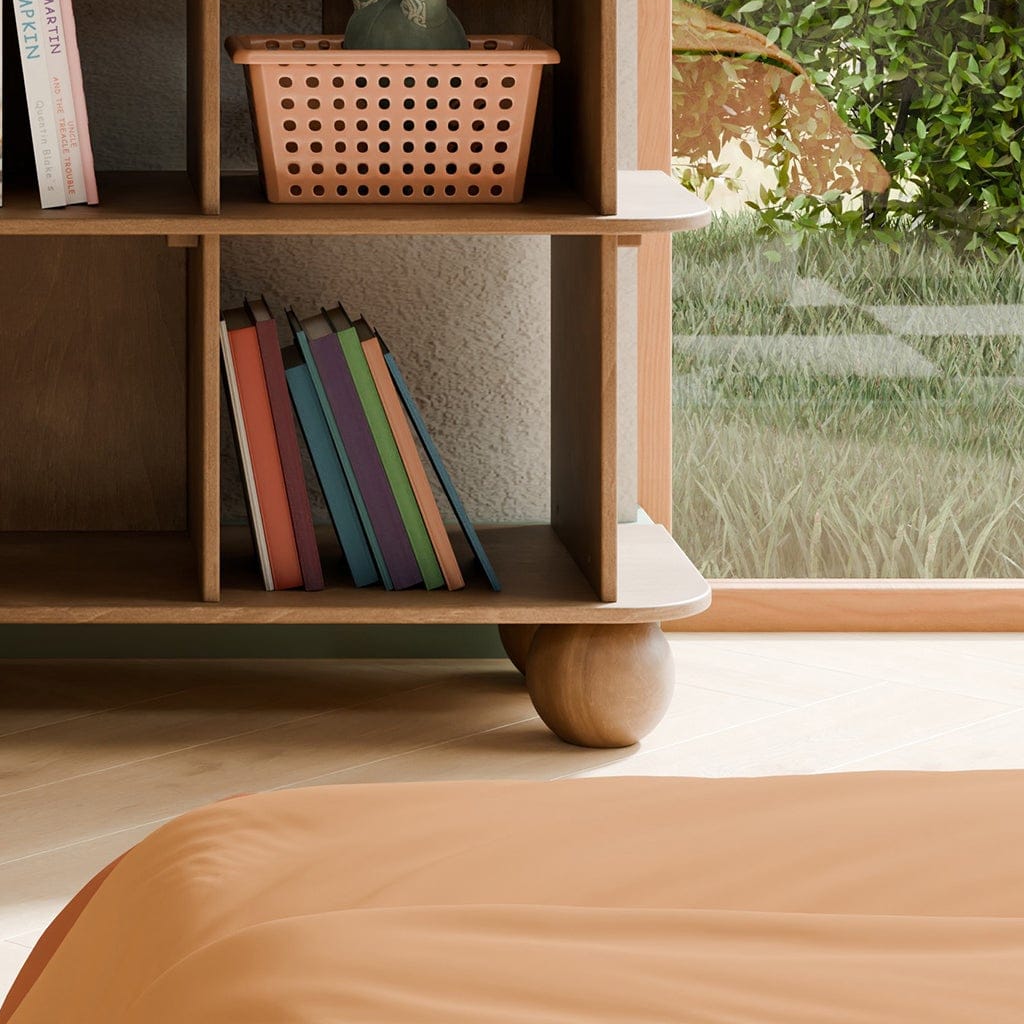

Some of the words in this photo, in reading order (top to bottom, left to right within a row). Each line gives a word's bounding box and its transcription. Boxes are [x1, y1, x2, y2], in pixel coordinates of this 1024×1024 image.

[52, 76, 62, 95] AND
[56, 97, 65, 113] THE
[35, 99, 49, 145] Quentin
[58, 117, 71, 155] TREACLE
[67, 120, 78, 148] UNCLE
[64, 157, 77, 195] TROUBLE
